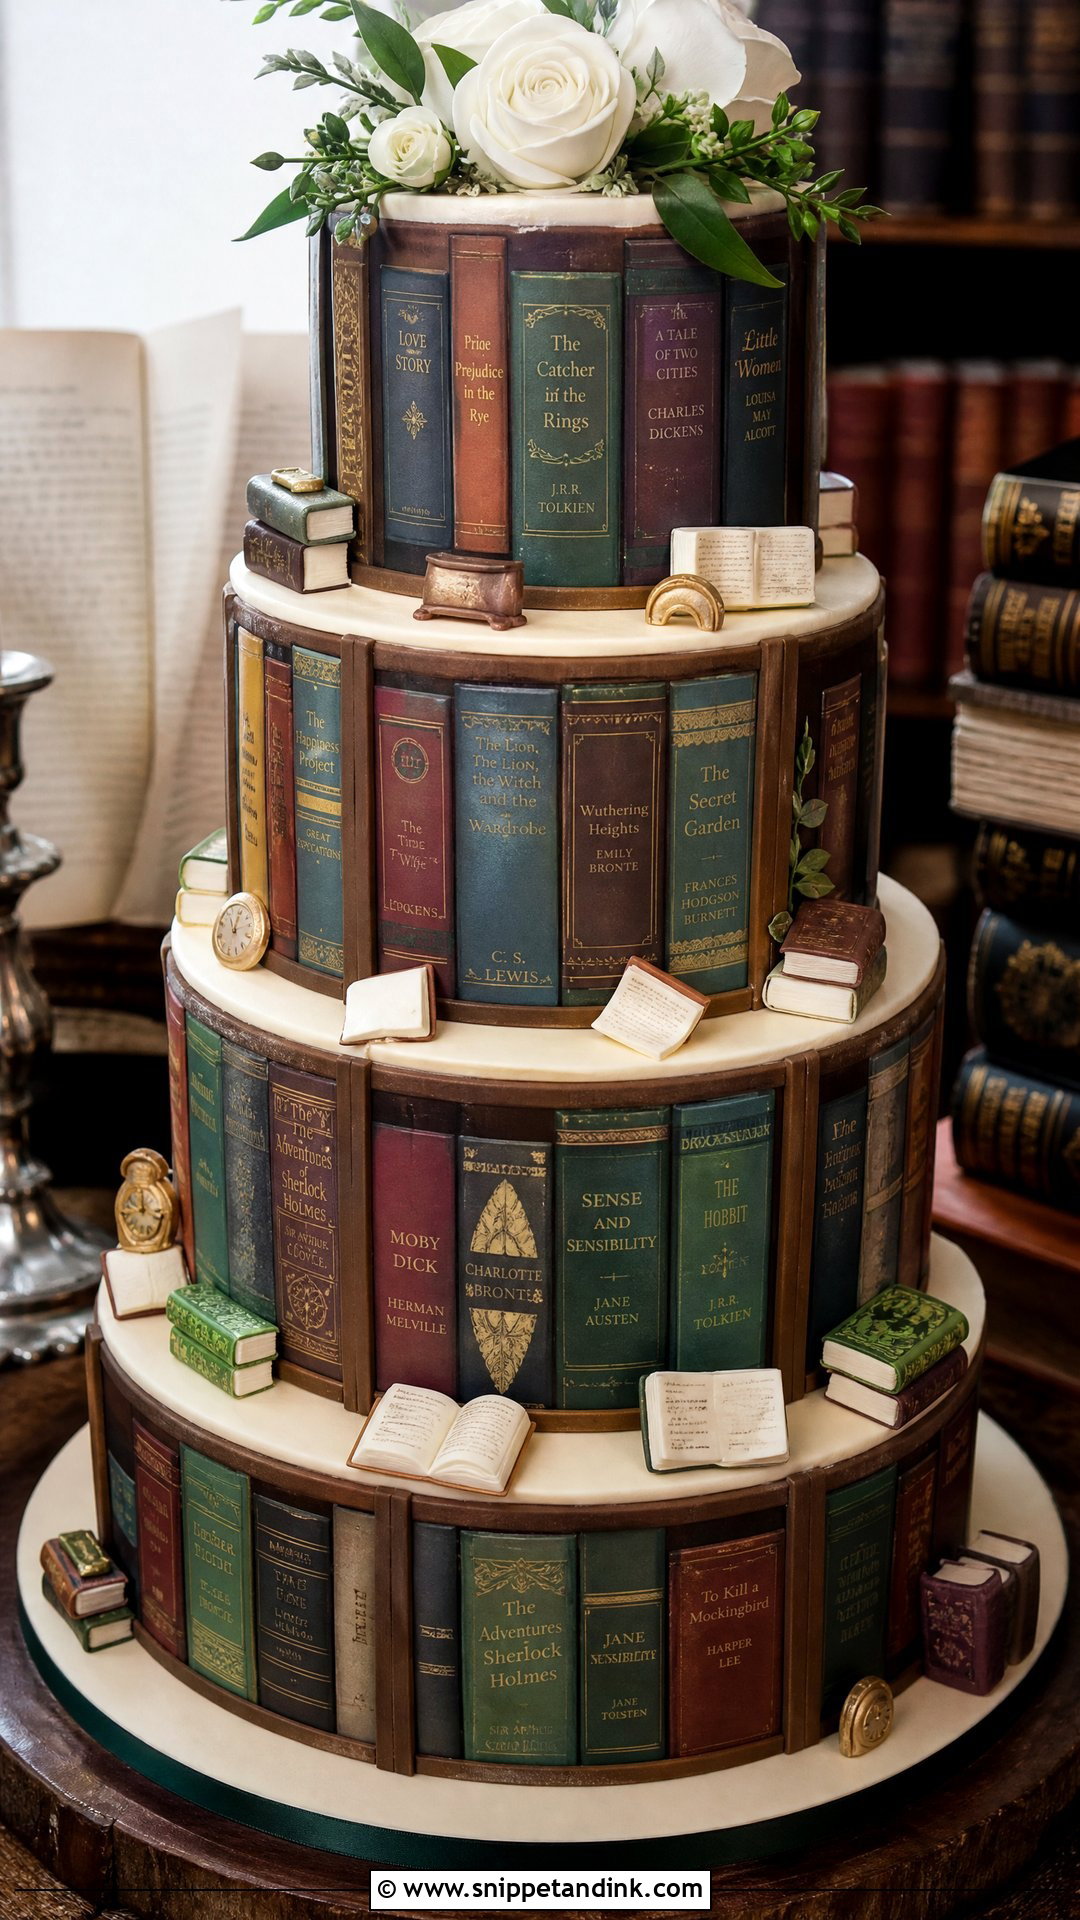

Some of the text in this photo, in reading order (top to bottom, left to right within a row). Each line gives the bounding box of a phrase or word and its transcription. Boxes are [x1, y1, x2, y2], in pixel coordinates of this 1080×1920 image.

[399, 330, 427, 349] LOVE
[550, 334, 581, 352] The
[655, 327, 698, 342] A TALE
[742, 327, 778, 352] Little
[655, 347, 698, 360] OF TWO
[395, 356, 432, 374] STORY
[455, 361, 504, 381] Prejudice
[537, 361, 595, 377] Catcher
[656, 366, 698, 380] CITIES
[734, 357, 782, 379] Women
[464, 385, 495, 400] in the
[563, 387, 586, 403] the
[745, 392, 777, 408] LOUISA
[470, 408, 489, 426] Rye
[648, 403, 705, 420] CHARLES
[752, 408, 772, 423] MAY
[543, 412, 589, 434] Rings
[649, 424, 704, 440] DICKENS
[744, 424, 777, 442] ALCOTT
[551, 484, 582, 497] J.R.R.
[538, 502, 595, 514] TOLKIEN
[306, 710, 325, 729] The
[475, 736, 501, 751] The
[299, 750, 335, 775] Project
[473, 754, 497, 768] The
[473, 772, 541, 789] the Witch
[700, 765, 730, 784] The
[480, 793, 537, 808] and the
[689, 791, 737, 811] Secret
[580, 803, 649, 819] Wuthering
[306, 828, 331, 842] GREAT
[401, 820, 422, 834] The
[589, 823, 640, 839] Heights
[684, 816, 741, 838] Garden
[596, 848, 633, 859] EMILY
[589, 861, 639, 873] BRONTE
[684, 874, 738, 893] FRANCES
[681, 890, 740, 911] HODGSON
[684, 907, 738, 925] BURNETT
[299, 1166, 308, 1178] of
[281, 1170, 327, 1202] Sherlock
[714, 1178, 740, 1199] THE
[582, 1191, 642, 1208] SENSE
[593, 1217, 631, 1230] AND
[704, 1205, 748, 1229] HOBBIT
[390, 1230, 441, 1250] MOBY
[567, 1236, 657, 1253] SENSIBILITY
[393, 1253, 438, 1274] DICK
[465, 1263, 543, 1282] CHARLOTTE
[387, 1297, 445, 1317] HERMAN
[594, 1296, 630, 1312] JANE
[709, 1295, 739, 1312] J.R.R.
[386, 1313, 447, 1335] MELVILLE
[585, 1313, 639, 1326] AUSTEN
[693, 1307, 752, 1331] TOLKIEN
[701, 1582, 759, 1603] To Kill a
[503, 1600, 536, 1616] The
[689, 1597, 769, 1625] Mockingbird
[478, 1622, 563, 1642] Adventures
[603, 1632, 645, 1649] JANE
[483, 1642, 562, 1666] Sherlock
[707, 1637, 753, 1656] HARPER
[719, 1655, 741, 1668] LEE
[490, 1669, 557, 1688] Holmes
[612, 1698, 638, 1709] JANE
